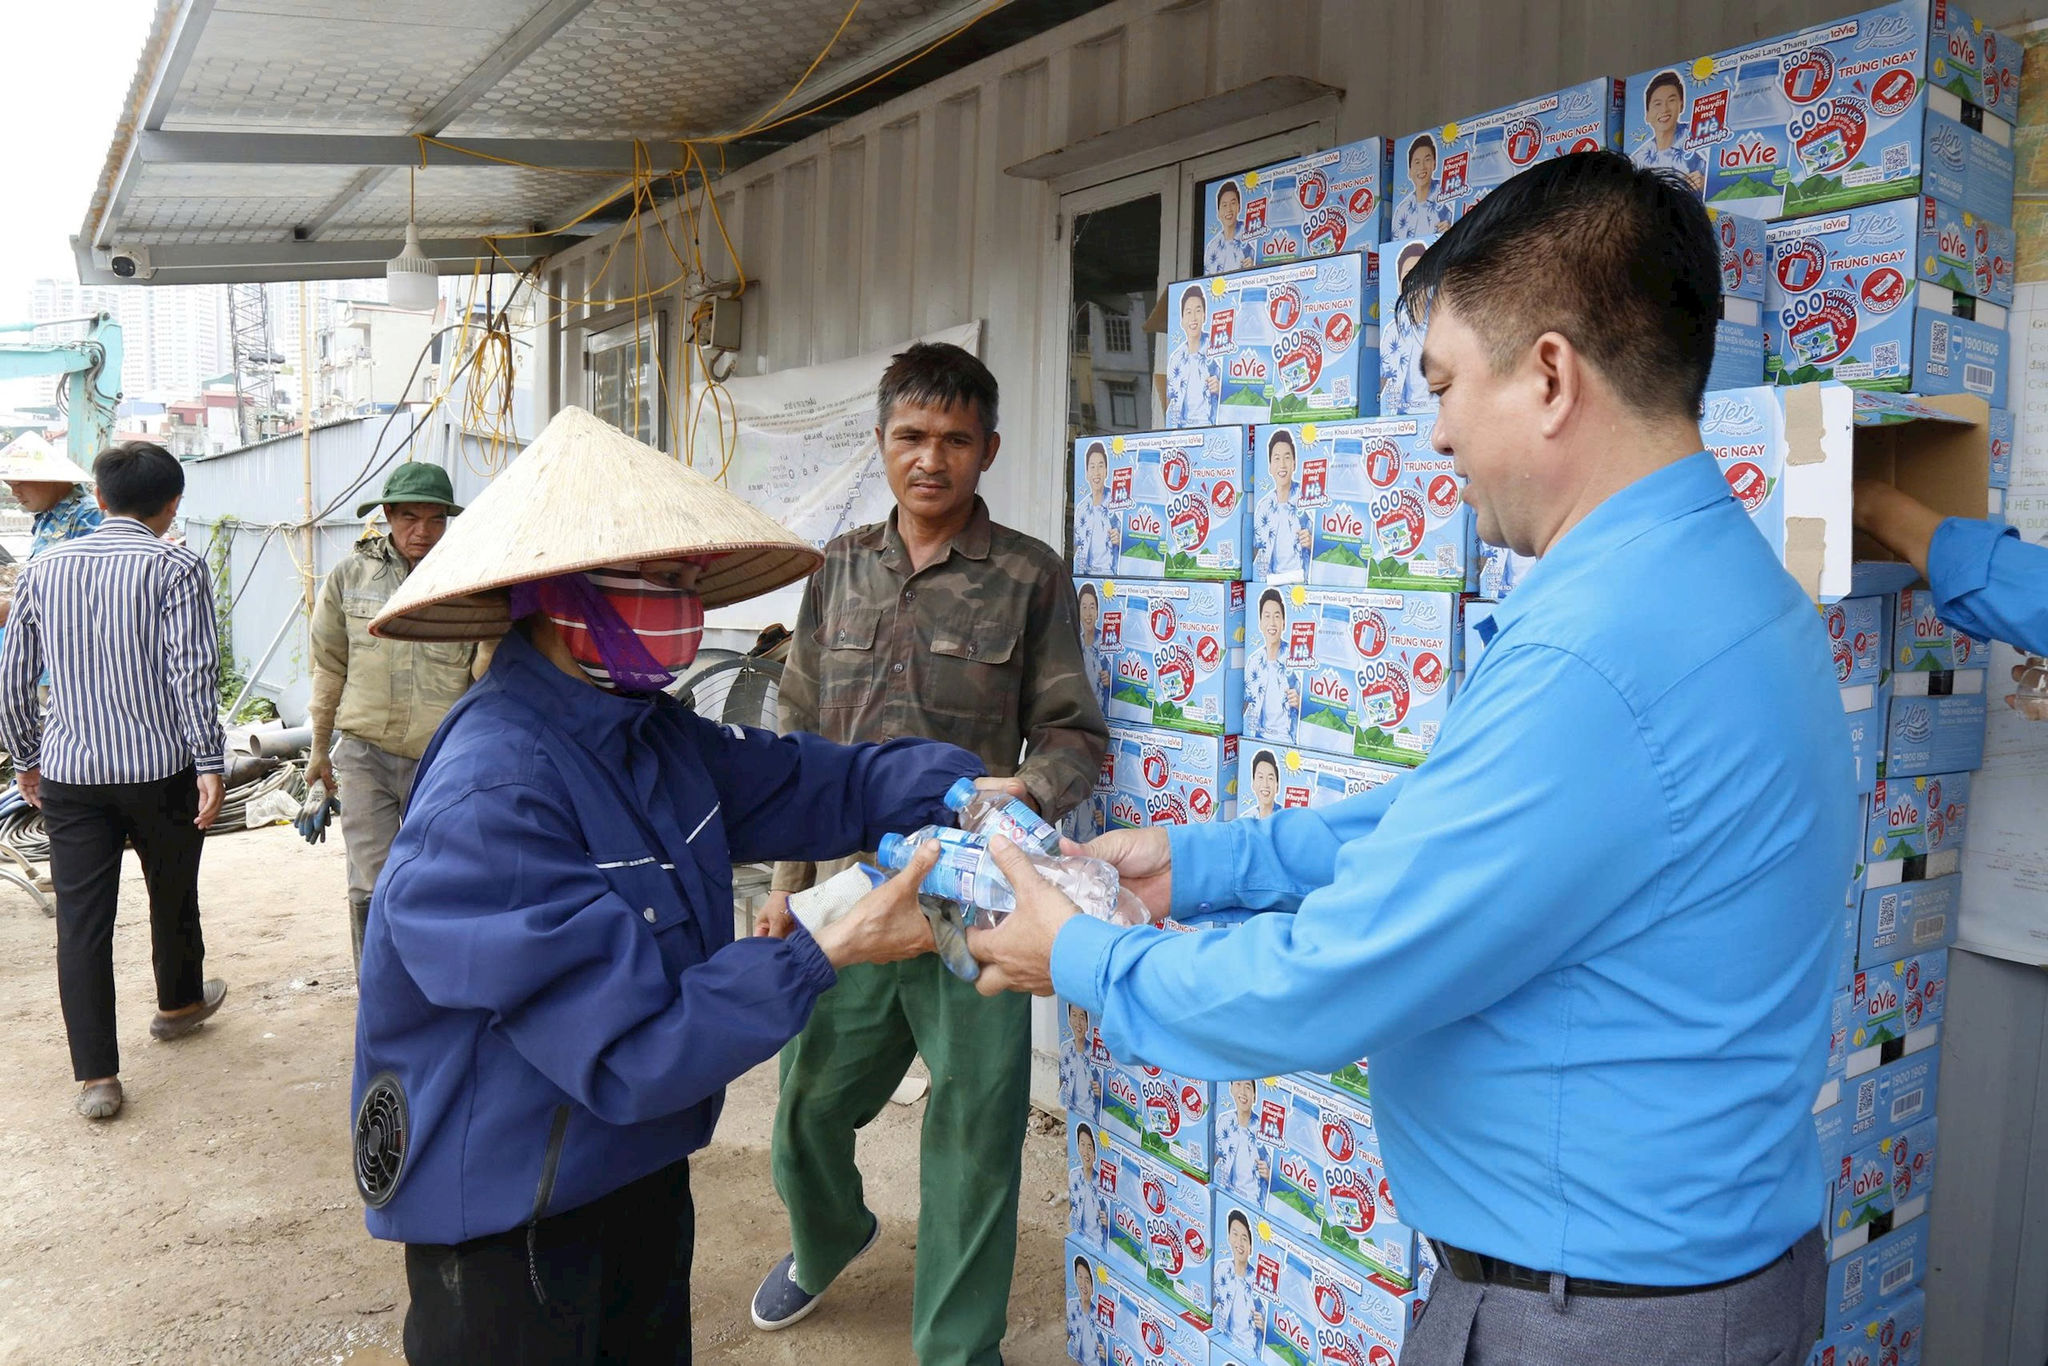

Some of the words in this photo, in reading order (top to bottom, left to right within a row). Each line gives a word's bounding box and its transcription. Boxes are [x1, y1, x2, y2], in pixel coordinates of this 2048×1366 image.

[1783, 51, 1808, 71] 600
[1882, 50, 1917, 67] NGAY
[1506, 120, 1525, 137] 600
[1575, 122, 1600, 136] NGAY
[1790, 102, 1830, 138] 600
[1303, 209, 1326, 236] 600
[1777, 240, 1802, 259] 600
[1872, 250, 1906, 265] NGAY
[1332, 298, 1354, 310] NGAY
[1783, 292, 1822, 327] 600
[1274, 331, 1300, 360] 600
[1730, 445, 1766, 458] NGAY
[1435, 460, 1453, 471] NGA
[1371, 489, 1400, 519] 600
[1420, 638, 1444, 648] NGAY
[1357, 660, 1386, 688] 600
[1142, 1080, 1162, 1098] 600
[1326, 1166, 1353, 1186] 600
[1318, 1329, 1344, 1348] 600
